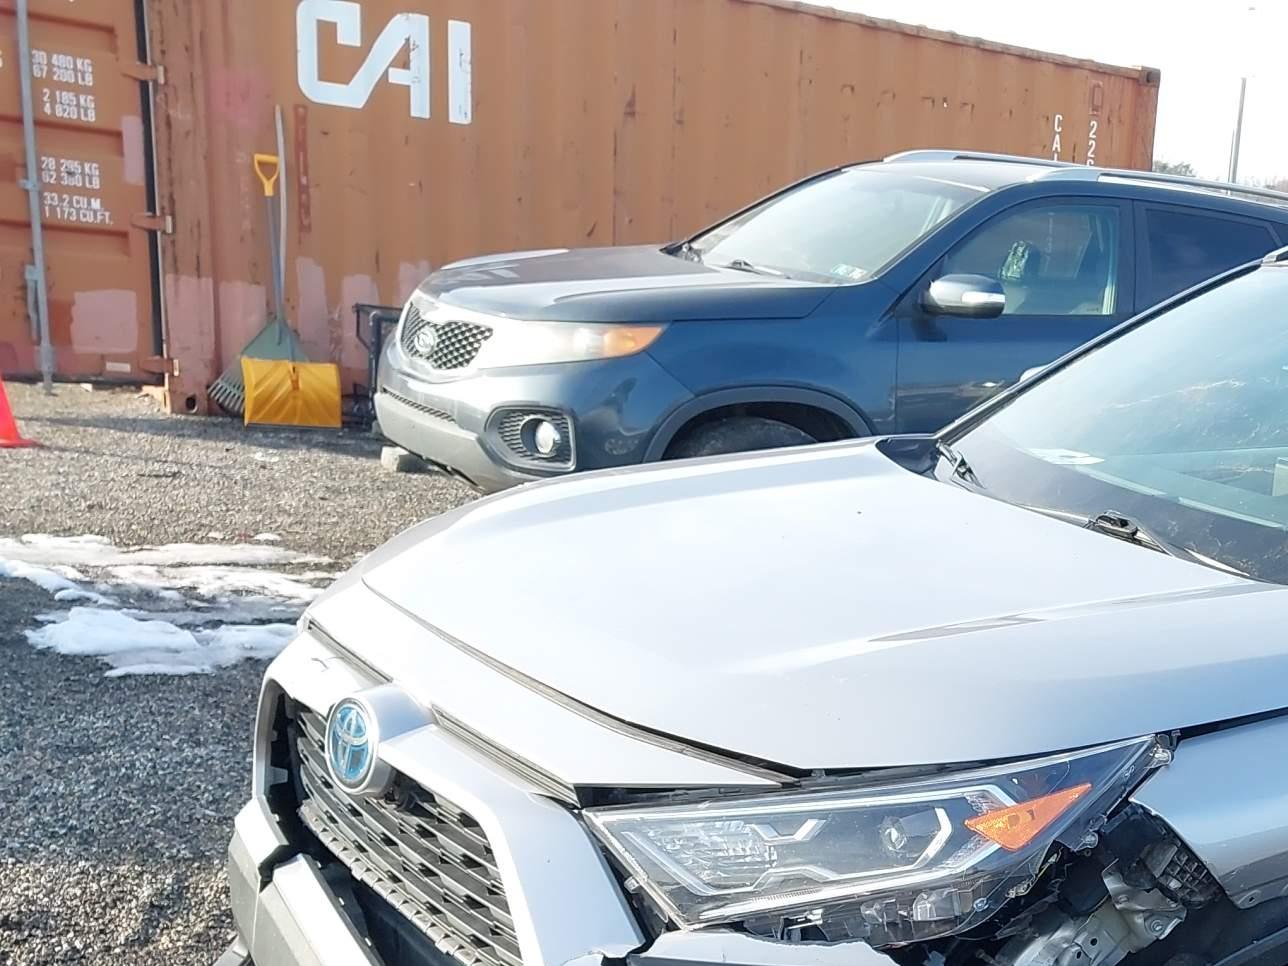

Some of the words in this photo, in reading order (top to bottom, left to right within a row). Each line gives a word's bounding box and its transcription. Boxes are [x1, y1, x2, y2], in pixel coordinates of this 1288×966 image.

[51, 54, 73, 69] 480
[76, 58, 92, 72] KG
[296, 0, 471, 124] CAI
[52, 67, 75, 83] 200
[78, 72, 93, 86] LB
[43, 89, 50, 101] 2
[56, 91, 77, 105] 185
[80, 94, 95, 108] KG
[44, 103, 51, 115] 4
[80, 108, 95, 122] LB
[41, 157, 55, 170] 28
[84, 162, 99, 175] KG
[85, 175, 100, 189] LB
[43, 192, 70, 208] 33.2
[45, 207, 49, 218] 1
[57, 207, 76, 221] 173
